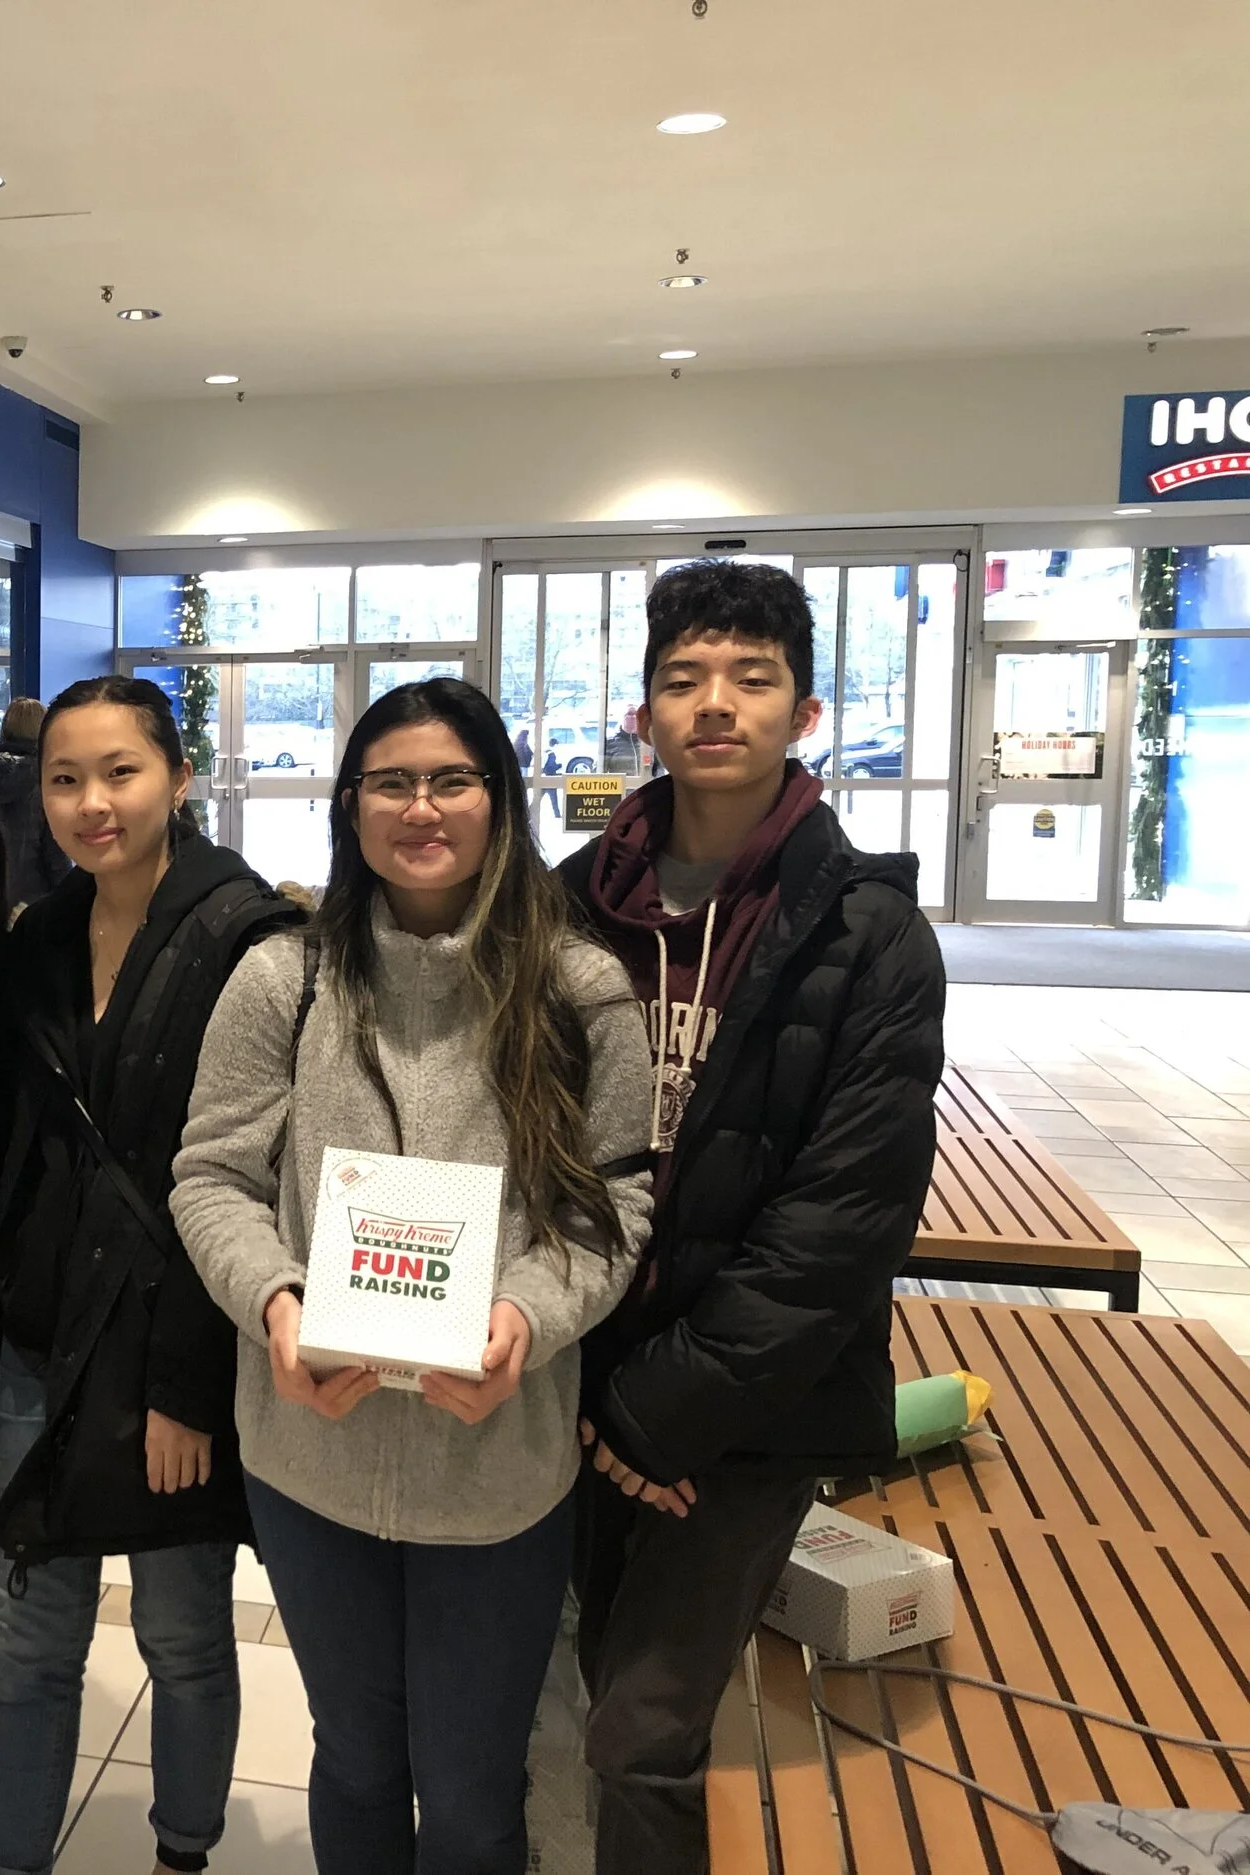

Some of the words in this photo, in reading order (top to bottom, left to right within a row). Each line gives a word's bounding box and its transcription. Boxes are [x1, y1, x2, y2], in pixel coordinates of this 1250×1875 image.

[1164, 458, 1250, 484] RESTA
[1021, 741, 1050, 750] HOLIDAY
[571, 781, 618, 791] CAUTION
[582, 797, 606, 806] WET
[577, 808, 611, 817] FLOOR
[356, 1218, 405, 1243] Krispy
[404, 1224, 454, 1245] Kreme
[357, 1236, 449, 1255] DOUGHNUTS
[351, 1249, 450, 1282] FUND
[350, 1275, 446, 1300] RAISING
[889, 1610, 917, 1628] FUND
